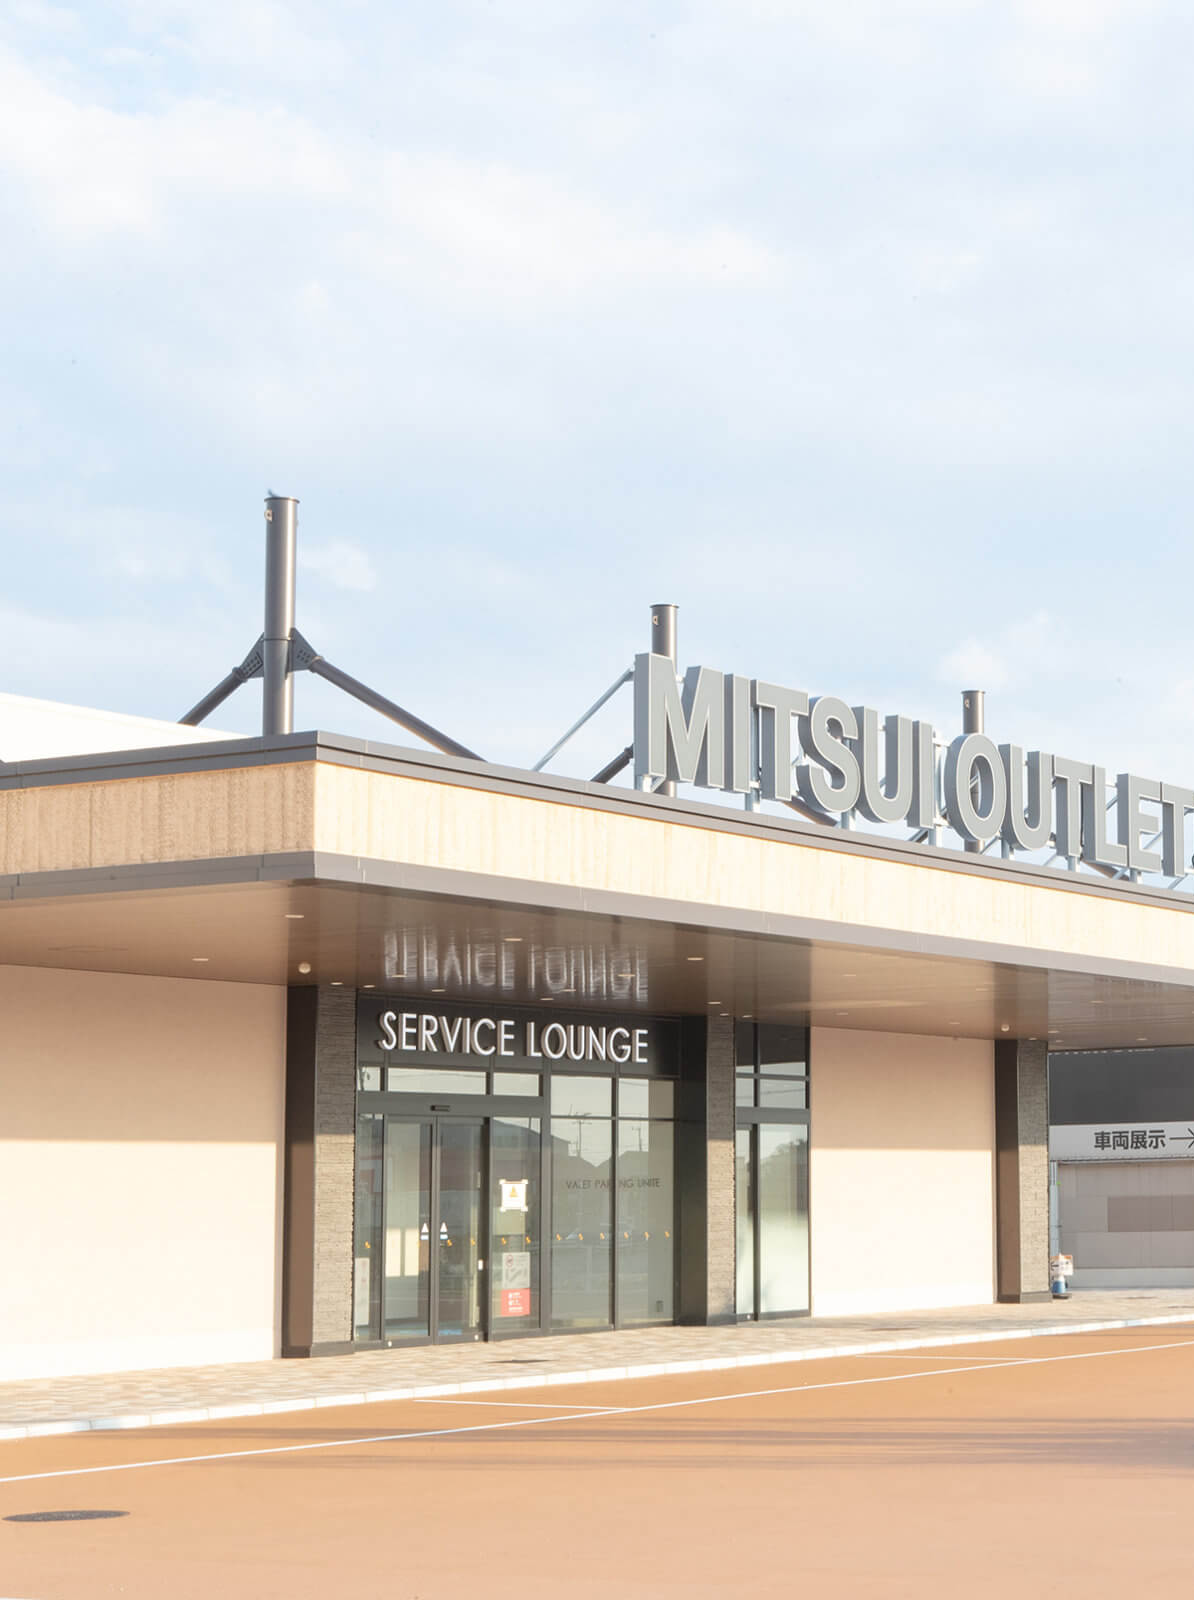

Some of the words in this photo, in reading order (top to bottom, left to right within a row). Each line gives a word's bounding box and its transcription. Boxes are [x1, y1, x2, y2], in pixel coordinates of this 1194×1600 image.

[634, 653, 937, 829] MITSUI
[944, 733, 1194, 877] OUTLET
[378, 1011, 515, 1056] SERVICE
[526, 1021, 649, 1063] LOUNGE
[1094, 1130, 1166, 1150] 車両展示
